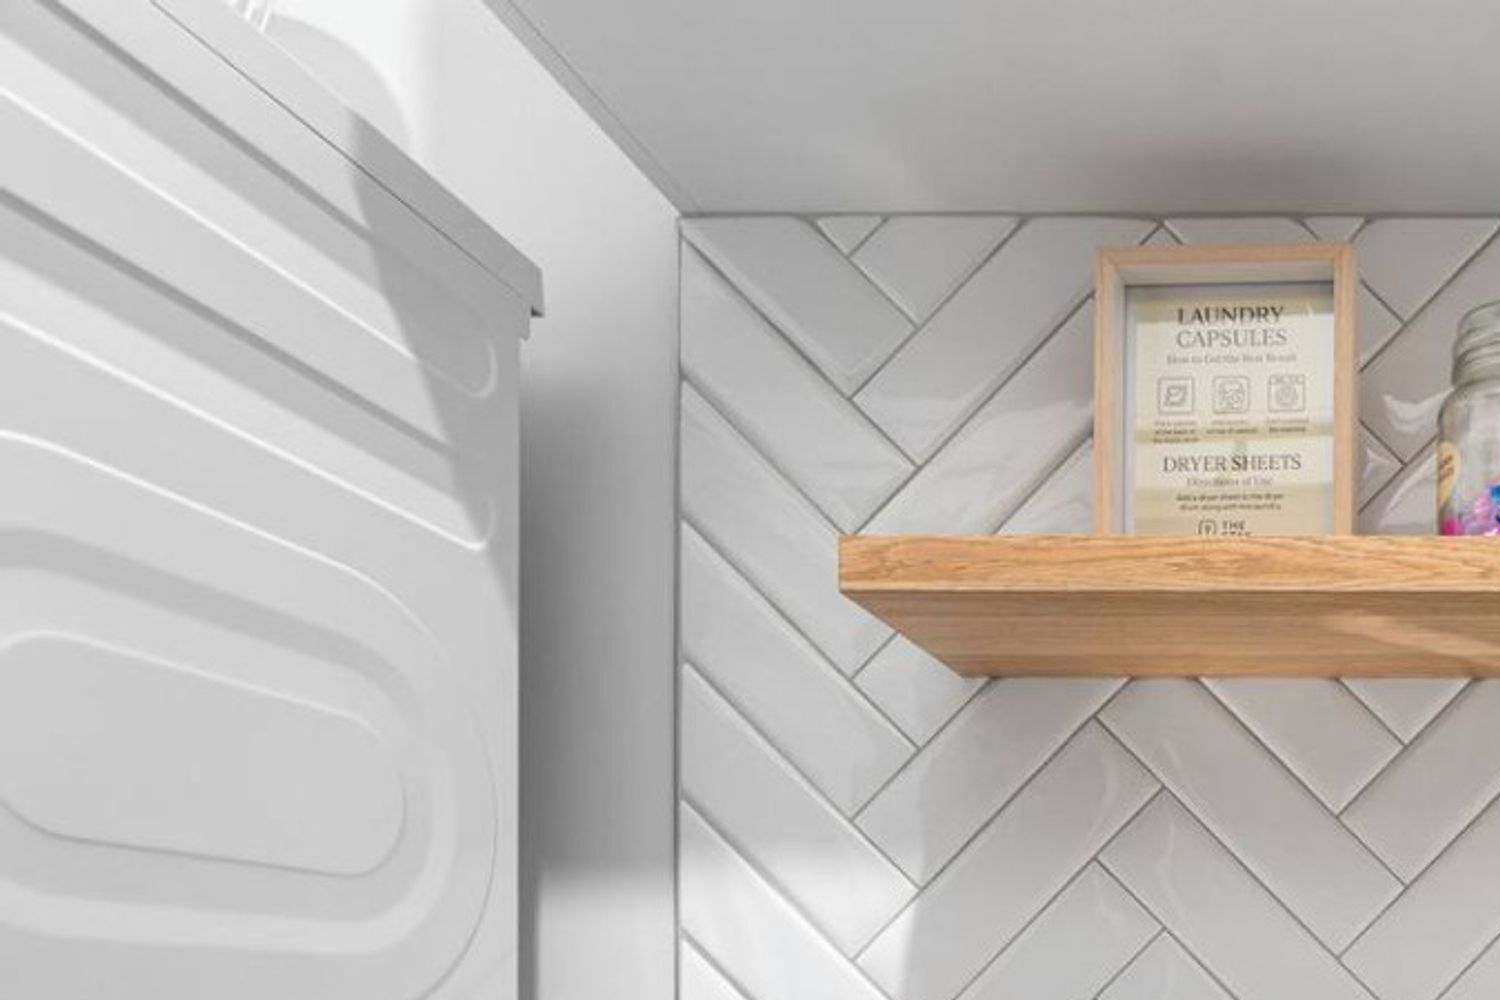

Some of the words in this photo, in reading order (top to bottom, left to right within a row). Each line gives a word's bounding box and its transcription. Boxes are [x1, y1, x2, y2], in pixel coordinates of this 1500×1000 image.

[1177, 306, 1284, 325] LAUNDRY
[1176, 328, 1287, 348] CAPSULES
[1163, 456, 1227, 472] DRYER
[1231, 453, 1302, 472] SHEETS
